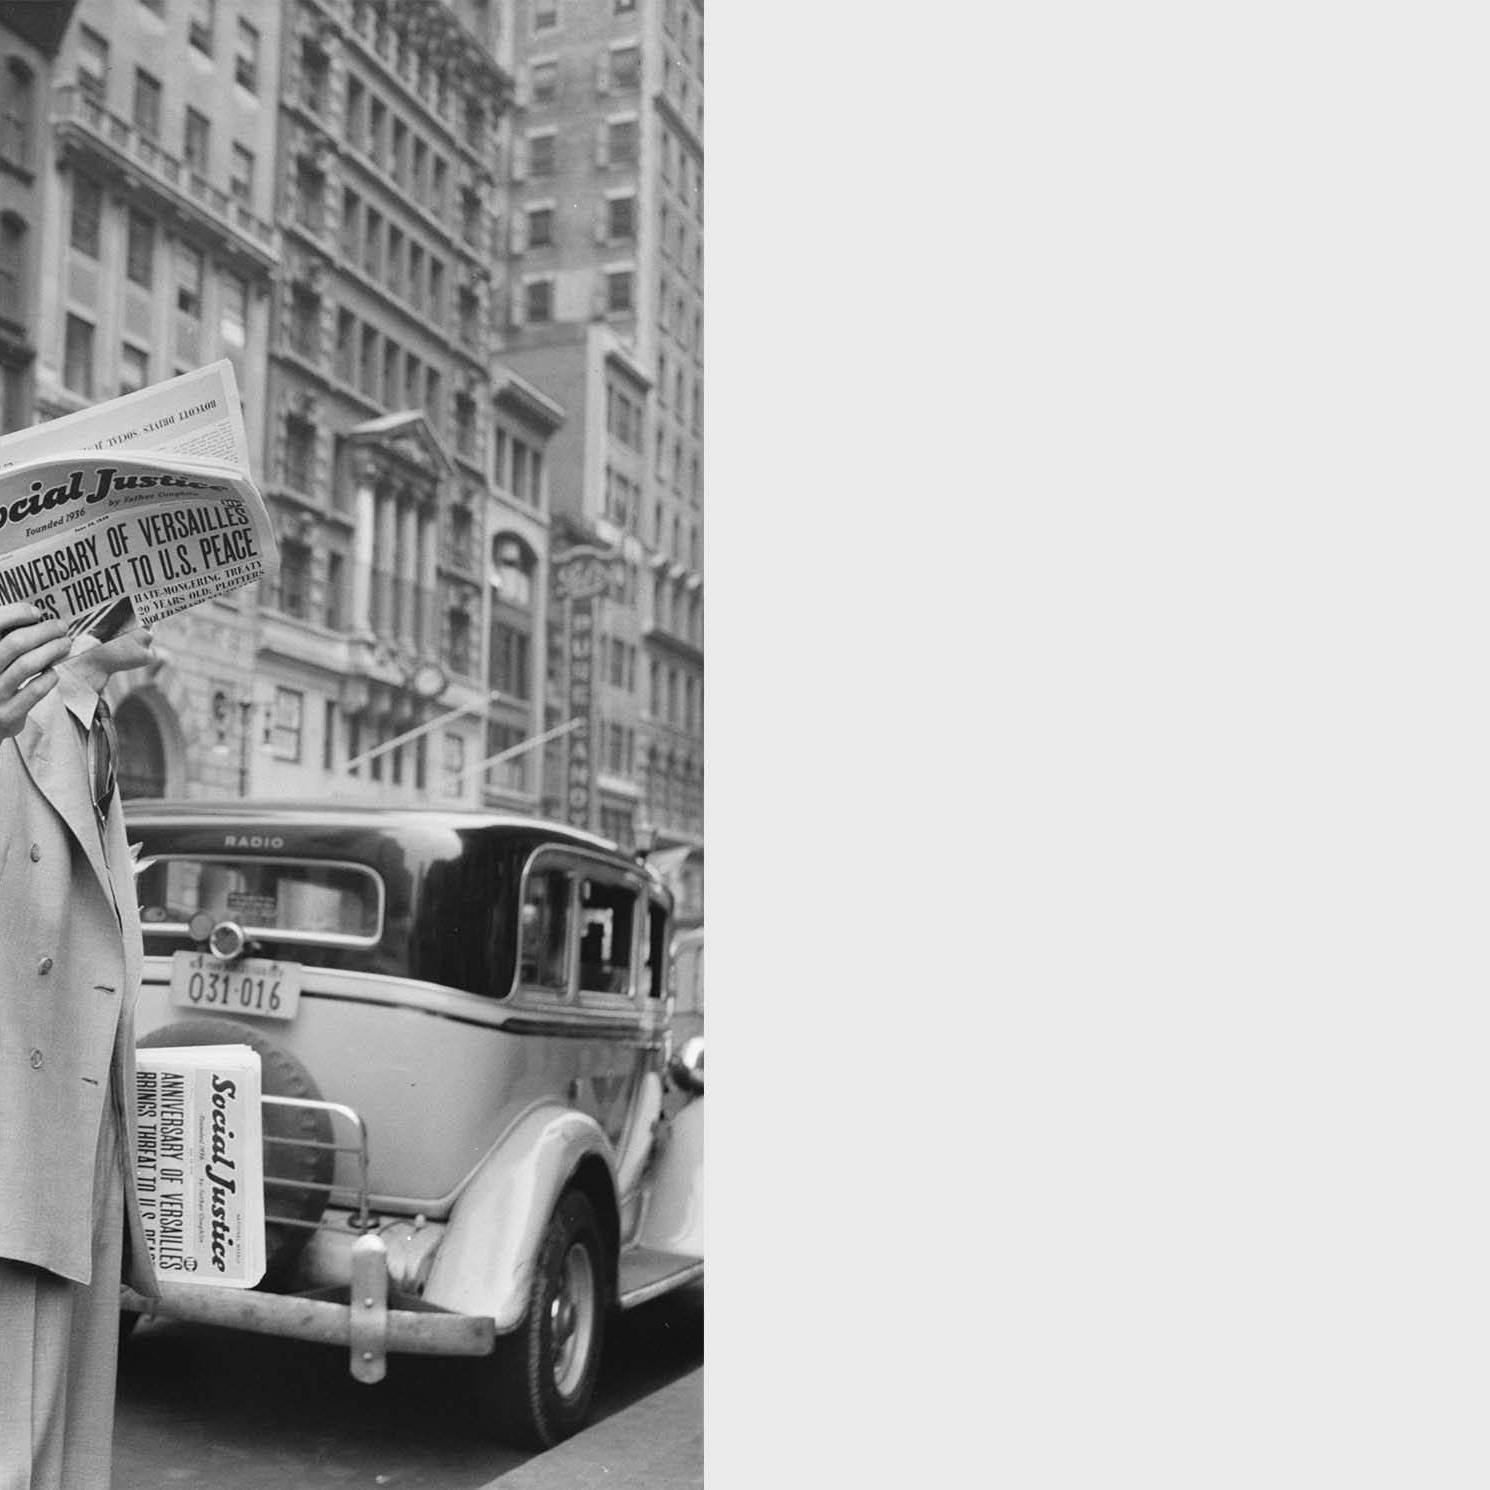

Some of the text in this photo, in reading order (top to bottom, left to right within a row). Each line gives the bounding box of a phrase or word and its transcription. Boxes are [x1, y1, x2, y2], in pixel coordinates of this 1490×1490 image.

[86, 468, 229, 505] Justice
[25, 507, 87, 538] Founded 1936
[106, 522, 129, 558] OF
[137, 506, 250, 548] VERSAILLES
[61, 562, 126, 616] THREAT
[127, 554, 155, 588] TO
[158, 543, 197, 581] U.S.
[199, 527, 258, 570] PEACE
[137, 604, 151, 617] 20
[153, 595, 186, 611] YEARS
[215, 568, 265, 592] PLOTTERS
[224, 559, 263, 579] TREATY
[224, 835, 284, 849] RADIO
[136, 1071, 157, 1118] BRINGS
[137, 1124, 157, 1171] THREAT
[137, 1176, 157, 1192] TO
[159, 1072, 185, 1271] ANNIVERSARY OF VERSAILLES
[204, 1073, 237, 1273] Social Justice
